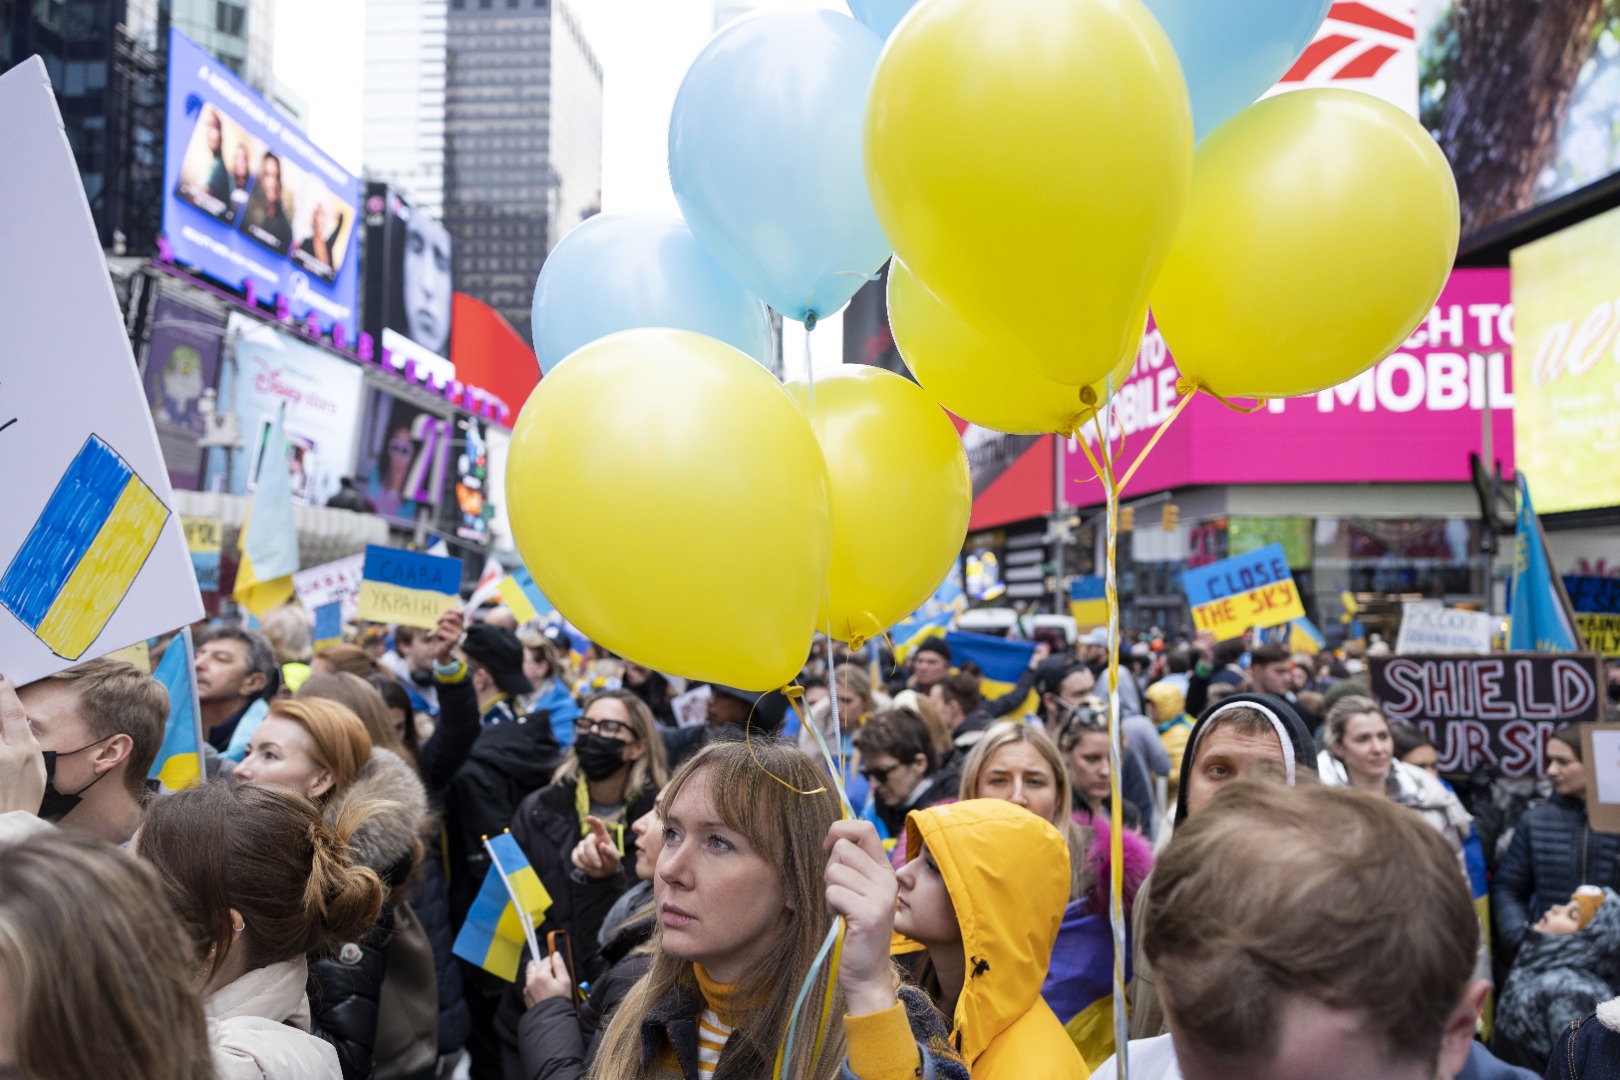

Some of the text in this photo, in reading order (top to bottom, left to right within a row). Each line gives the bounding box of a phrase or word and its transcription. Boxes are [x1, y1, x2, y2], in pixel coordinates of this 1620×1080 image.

[1531, 297, 1620, 388] ae
[379, 560, 444, 587] СЛАВА
[1206, 557, 1286, 600] CLOSE
[1195, 582, 1293, 628] THE SKY
[1382, 659, 1596, 720] SHIELD
[1389, 717, 1499, 773] UR
